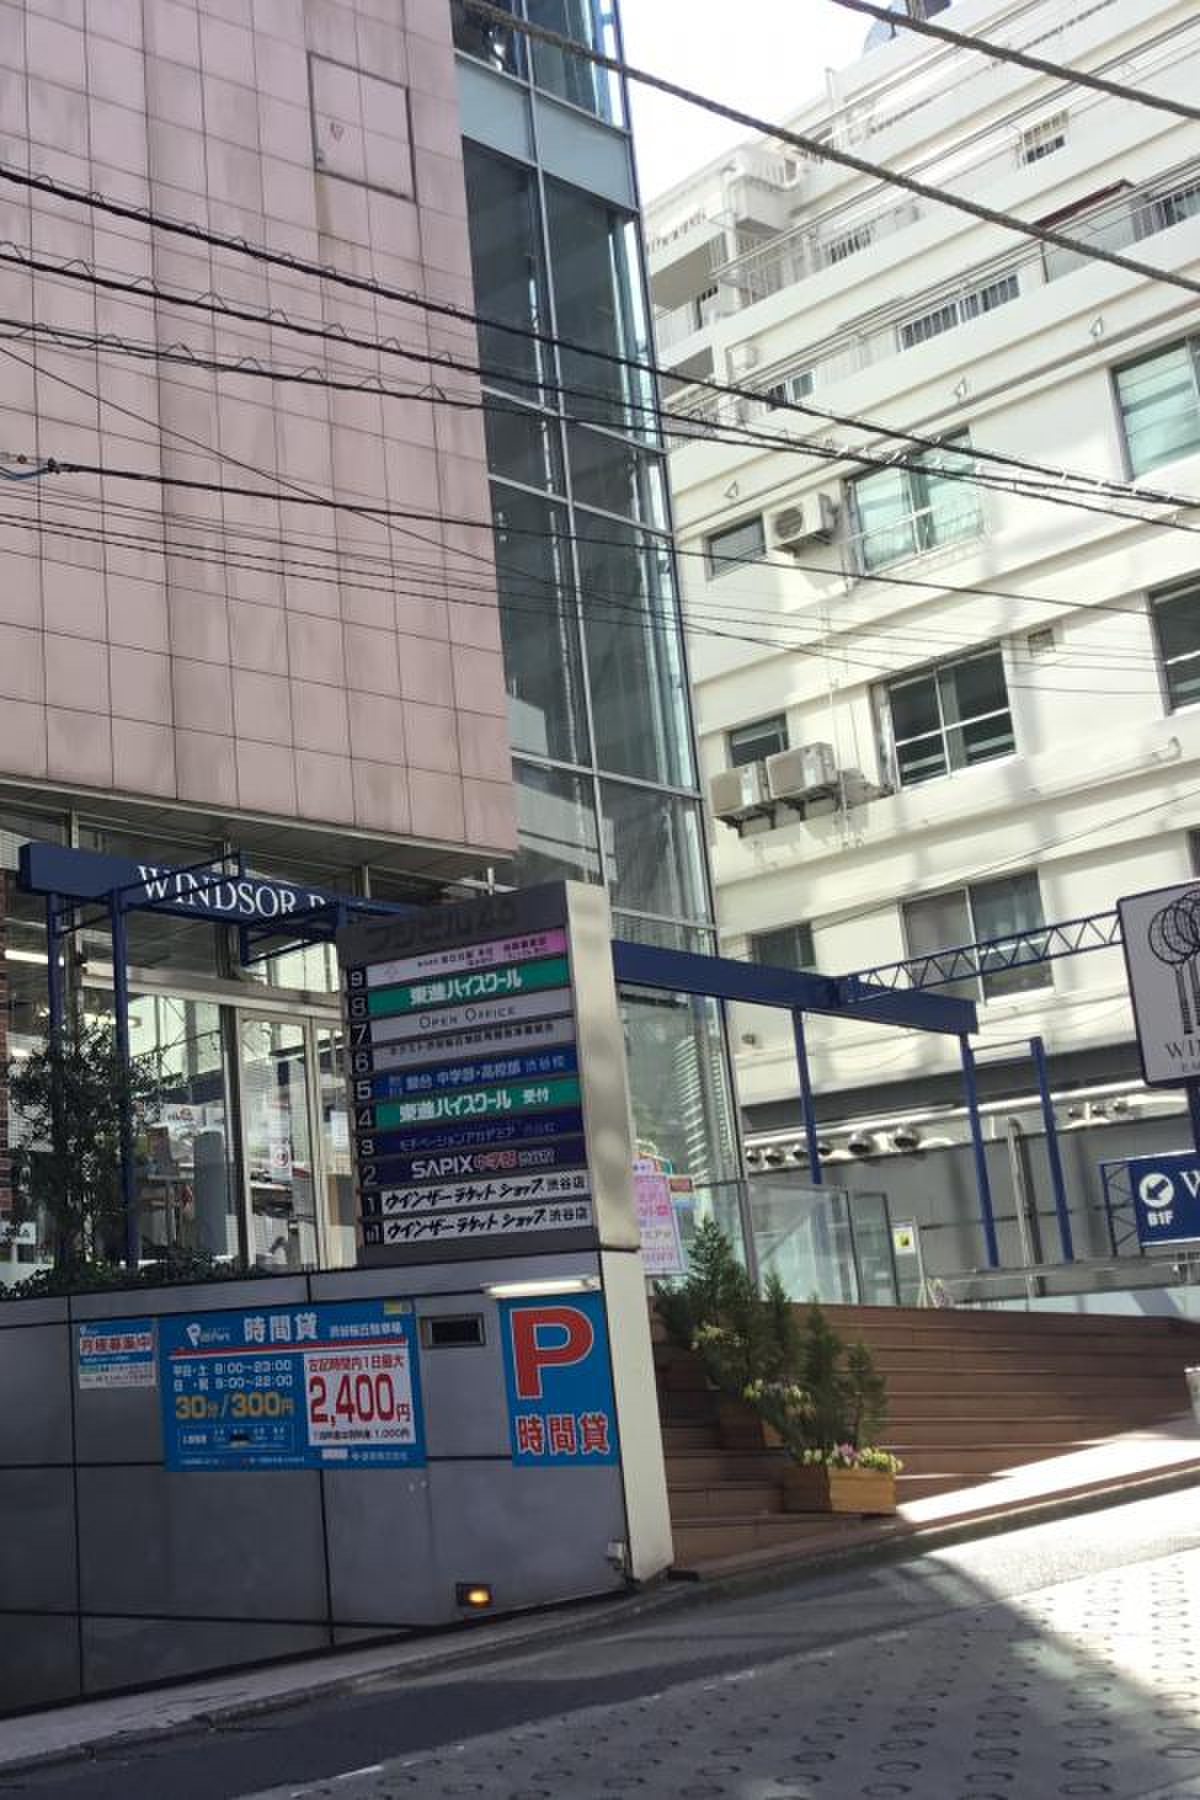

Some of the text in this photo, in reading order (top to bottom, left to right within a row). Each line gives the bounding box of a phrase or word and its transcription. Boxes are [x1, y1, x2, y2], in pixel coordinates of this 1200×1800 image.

[138, 864, 296, 918] WINDSOR
[409, 968, 522, 1005] 東進ハイスクール
[354, 1025, 367, 1042] 7
[355, 1054, 369, 1072] 6
[356, 1081, 372, 1100] 5
[358, 1108, 372, 1127] 4
[400, 1089, 512, 1123] 東進ハイスクール
[361, 1138, 375, 1155] 3
[363, 1165, 377, 1186] 2
[411, 1153, 474, 1180] SAPIX
[1147, 1209, 1175, 1228] B1F
[243, 1312, 318, 1343] 時間貸
[510, 1305, 595, 1400] P
[515, 1410, 611, 1455] 時間貸
